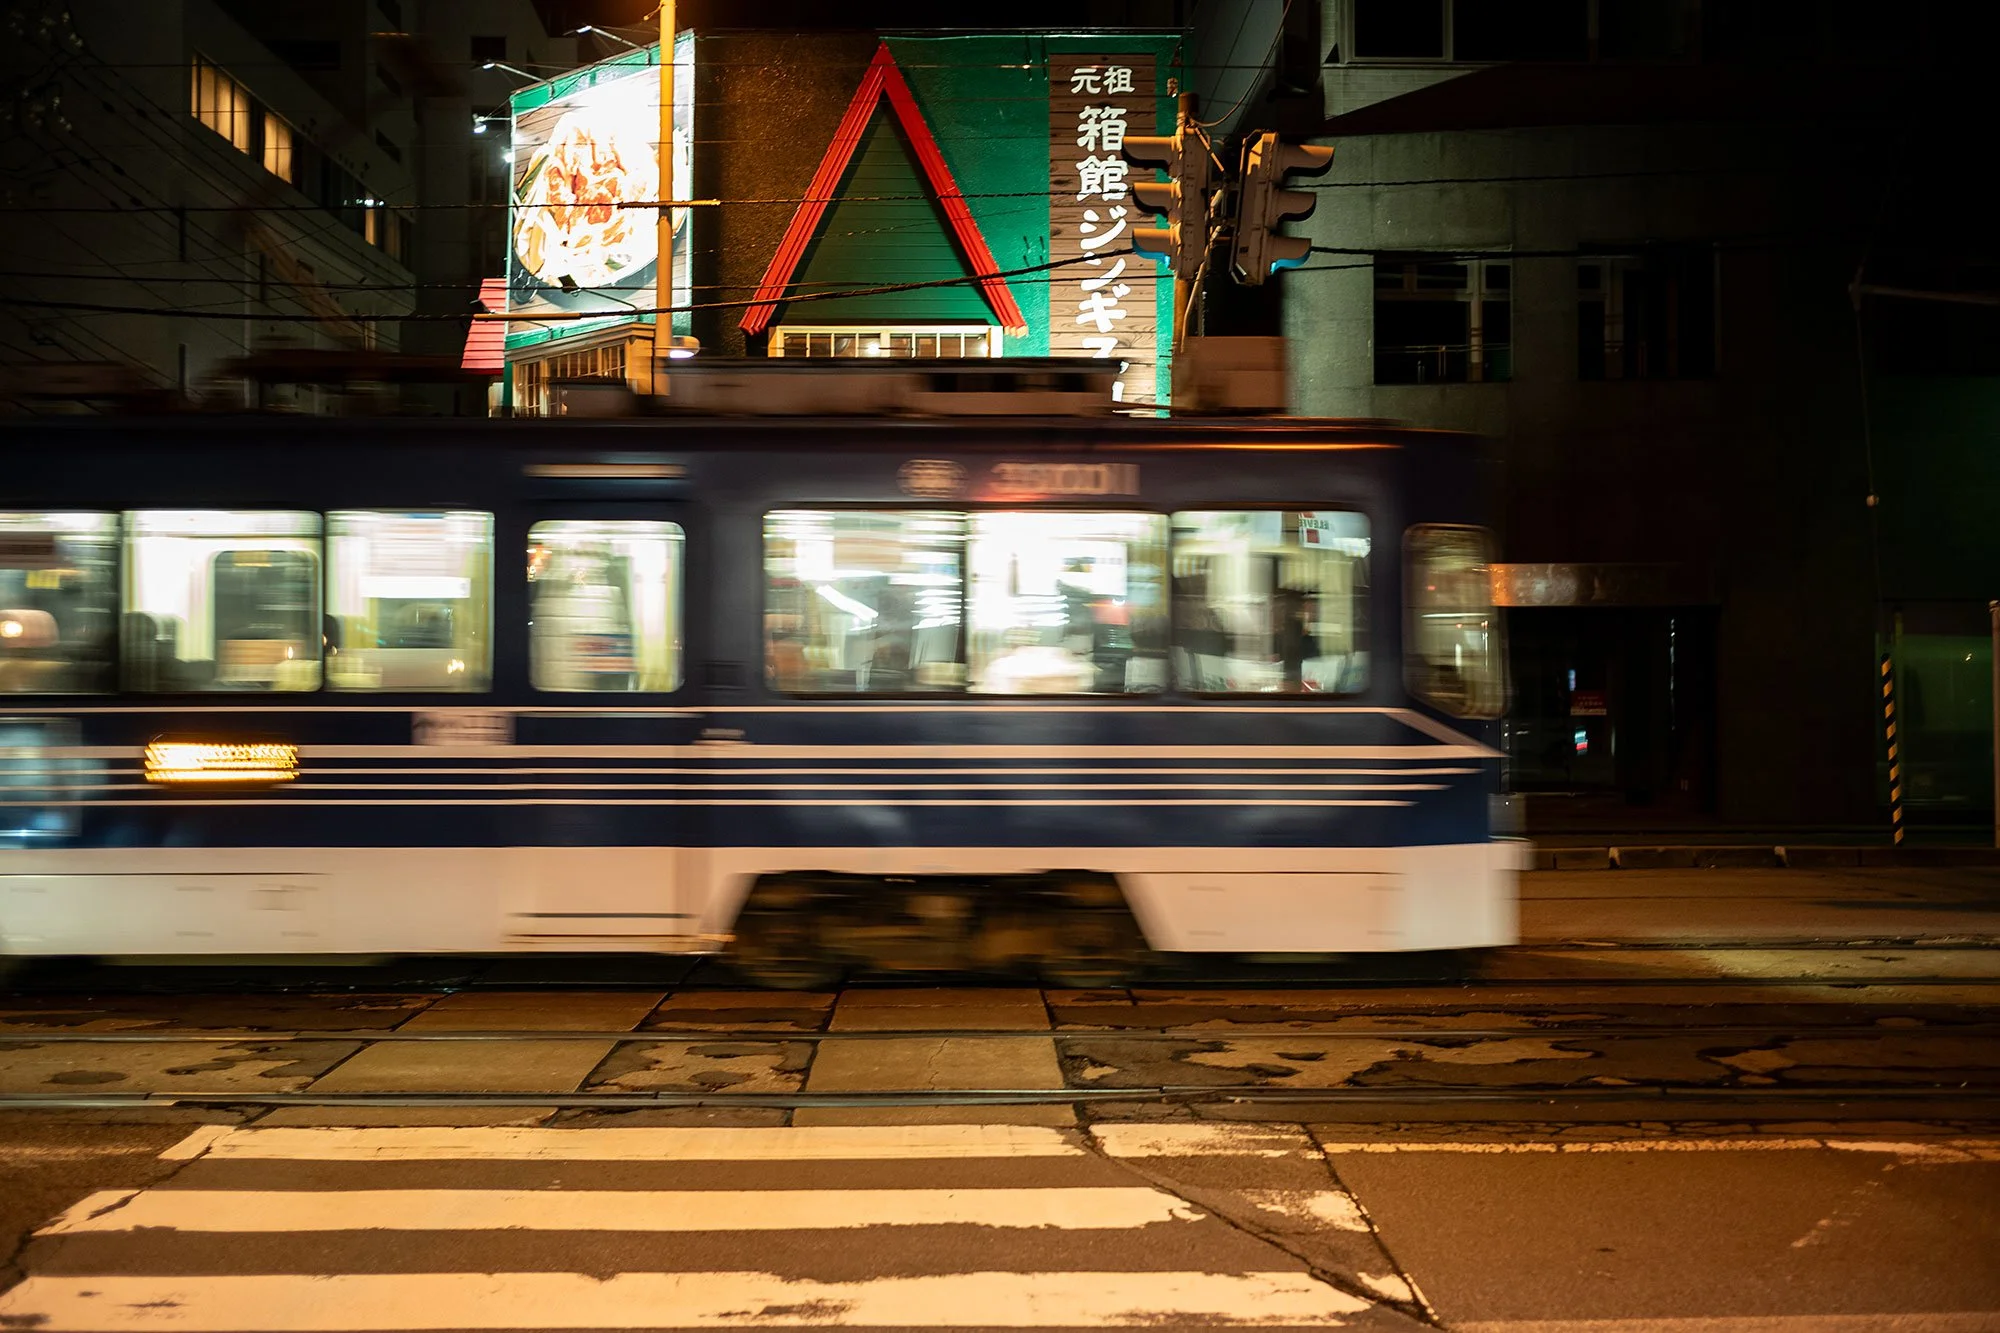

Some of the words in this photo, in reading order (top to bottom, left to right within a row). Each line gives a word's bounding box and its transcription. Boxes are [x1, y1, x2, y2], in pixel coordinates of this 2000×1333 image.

[1070, 66, 1135, 95] 元祖
[1076, 105, 1130, 402] 箱館ジンギス
